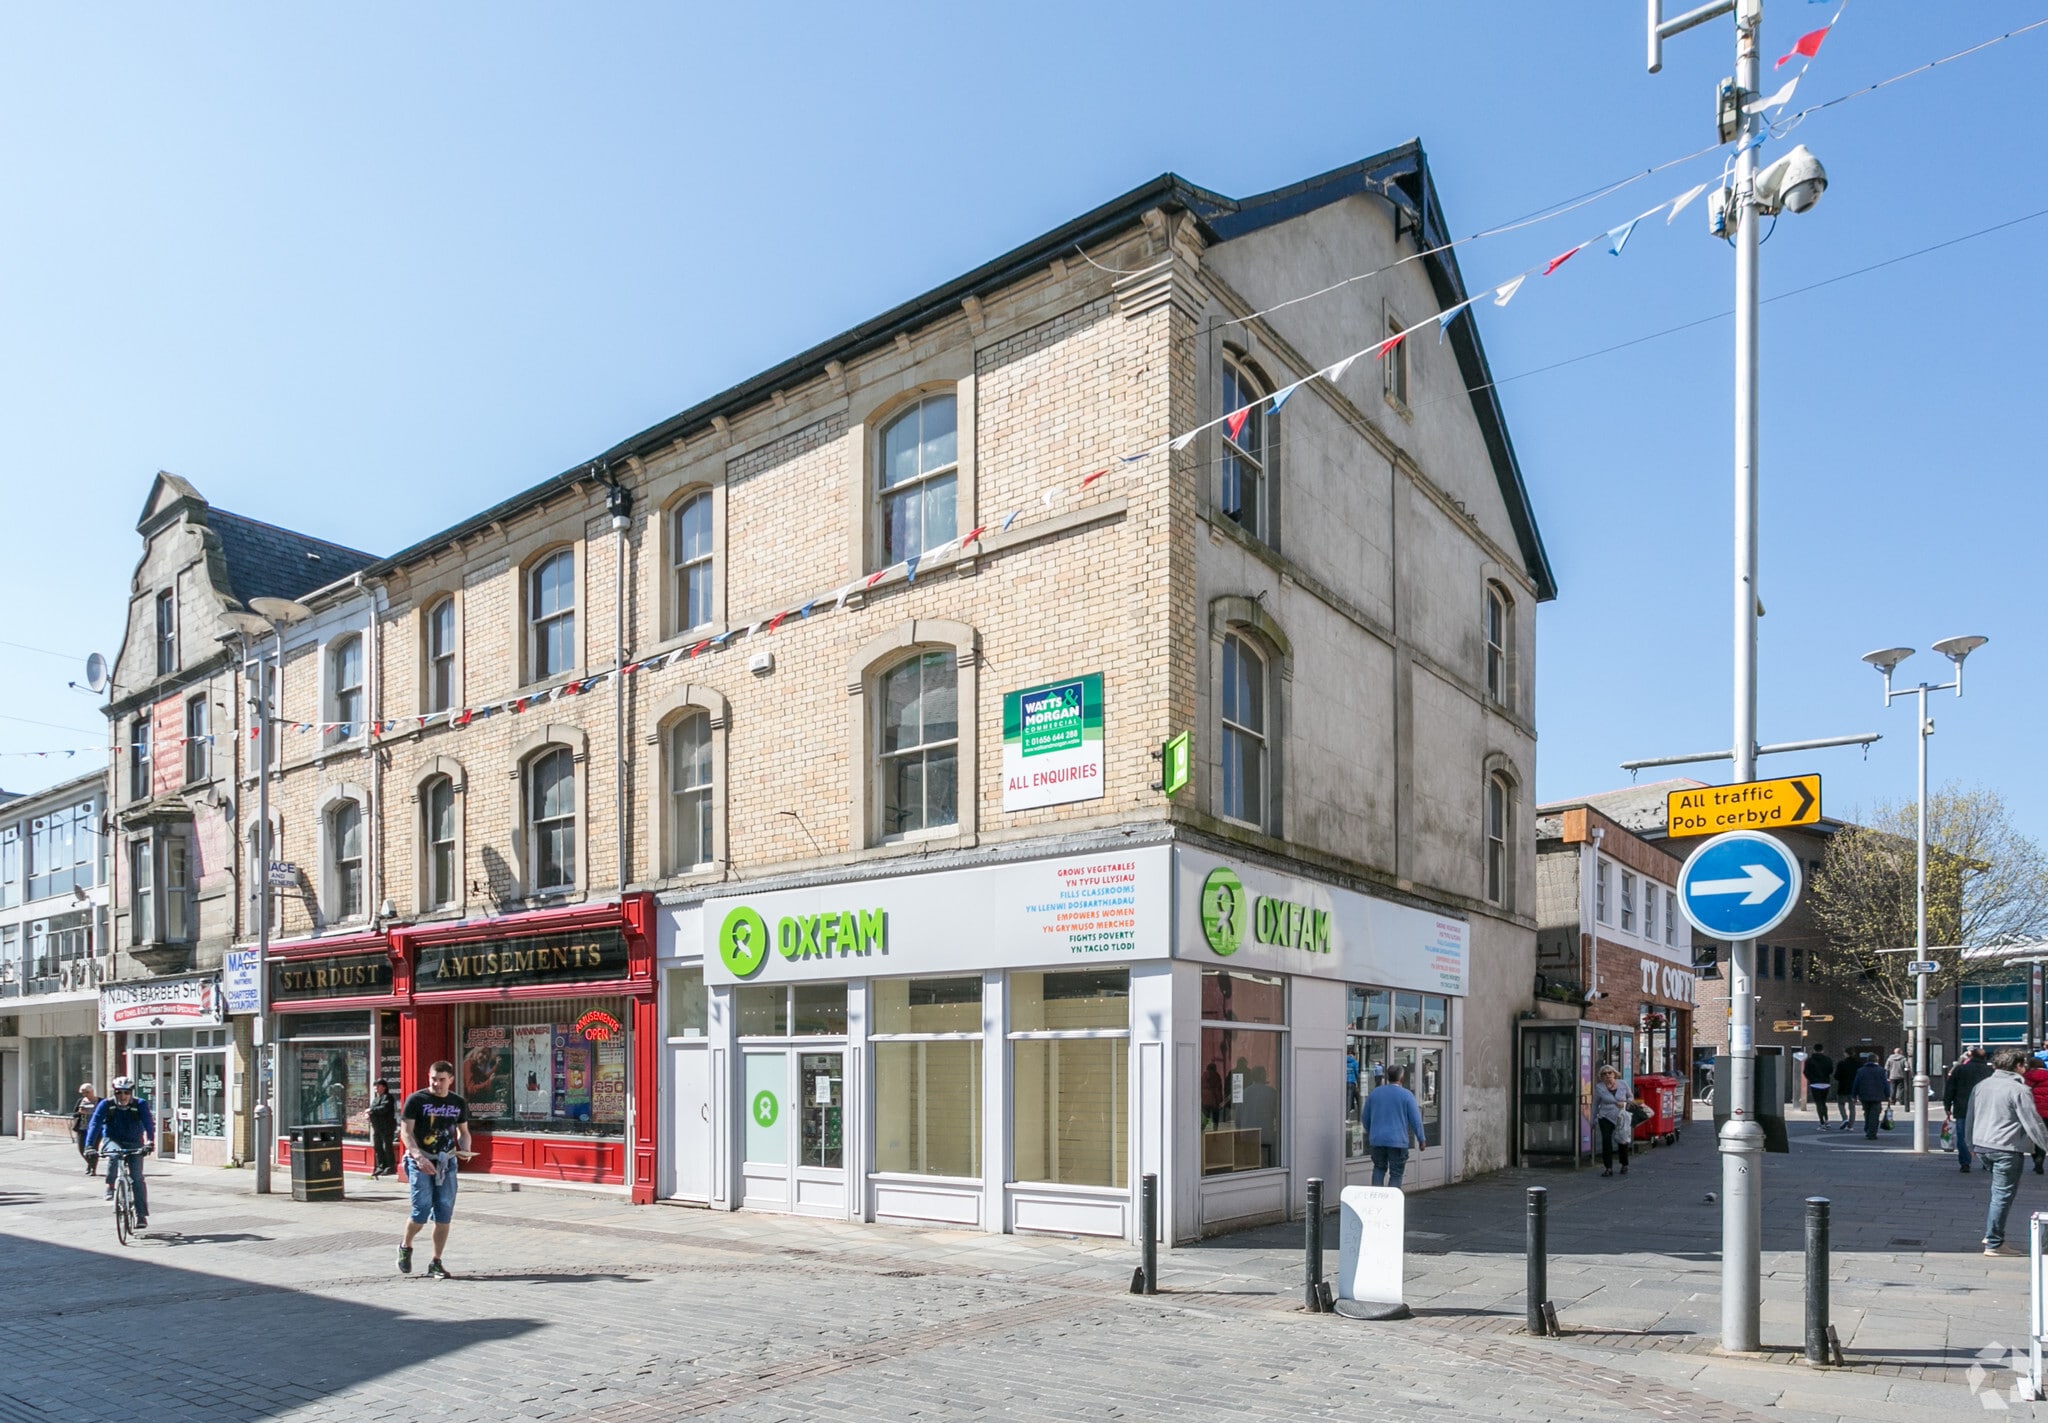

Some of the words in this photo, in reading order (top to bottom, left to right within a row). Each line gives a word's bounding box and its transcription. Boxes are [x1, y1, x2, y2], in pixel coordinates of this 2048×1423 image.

[1025, 697, 1062, 714] WATTS
[1062, 688, 1079, 707] &
[1025, 706, 1080, 726] MORGAN
[1025, 719, 1078, 734] COMMERCIAL
[1031, 735, 1051, 746] 01656
[1052, 732, 1064, 742] 644
[1009, 775, 1029, 791] ALL
[1033, 763, 1097, 787] ENQUIRIES
[1680, 794, 1705, 809] All
[1714, 787, 1774, 805] traffic
[1673, 815, 1707, 830] Pob
[1716, 806, 1781, 825] cerbyd
[1058, 867, 1085, 877] GROWS
[1087, 862, 1135, 874] VEGETABLES
[1080, 877, 1100, 886] TYFU
[1102, 874, 1135, 884] LLYSIAU
[1060, 889, 1080, 898] FILLS
[1082, 885, 1135, 896] CLASSROOMS
[1038, 902, 1066, 912] LLENWI
[1068, 897, 1135, 910] DOSBARTHIADAU
[1057, 911, 1100, 921] EMPOWERS
[1102, 908, 1135, 918] WOMEN
[778, 907, 886, 958] OXFAM
[1056, 922, 1094, 932] GRYMUSO
[1096, 920, 1135, 929] MERCHED
[1255, 896, 1331, 954] OXFAM
[1069, 933, 1096, 942] FIGHTS
[1098, 931, 1135, 940] POVERTY
[1071, 946, 1082, 954] YN
[1084, 944, 1110, 952] TACLO
[1112, 942, 1135, 950] TLODI
[228, 951, 257, 972] MACE
[436, 943, 602, 979] AMUSEMENTS
[283, 964, 379, 991] STARDUST
[1640, 958, 1659, 996] TY
[140, 985, 180, 1002] BARBER
[575, 1010, 620, 1034] AMUSEMENTS
[585, 1028, 610, 1041] OPEN
